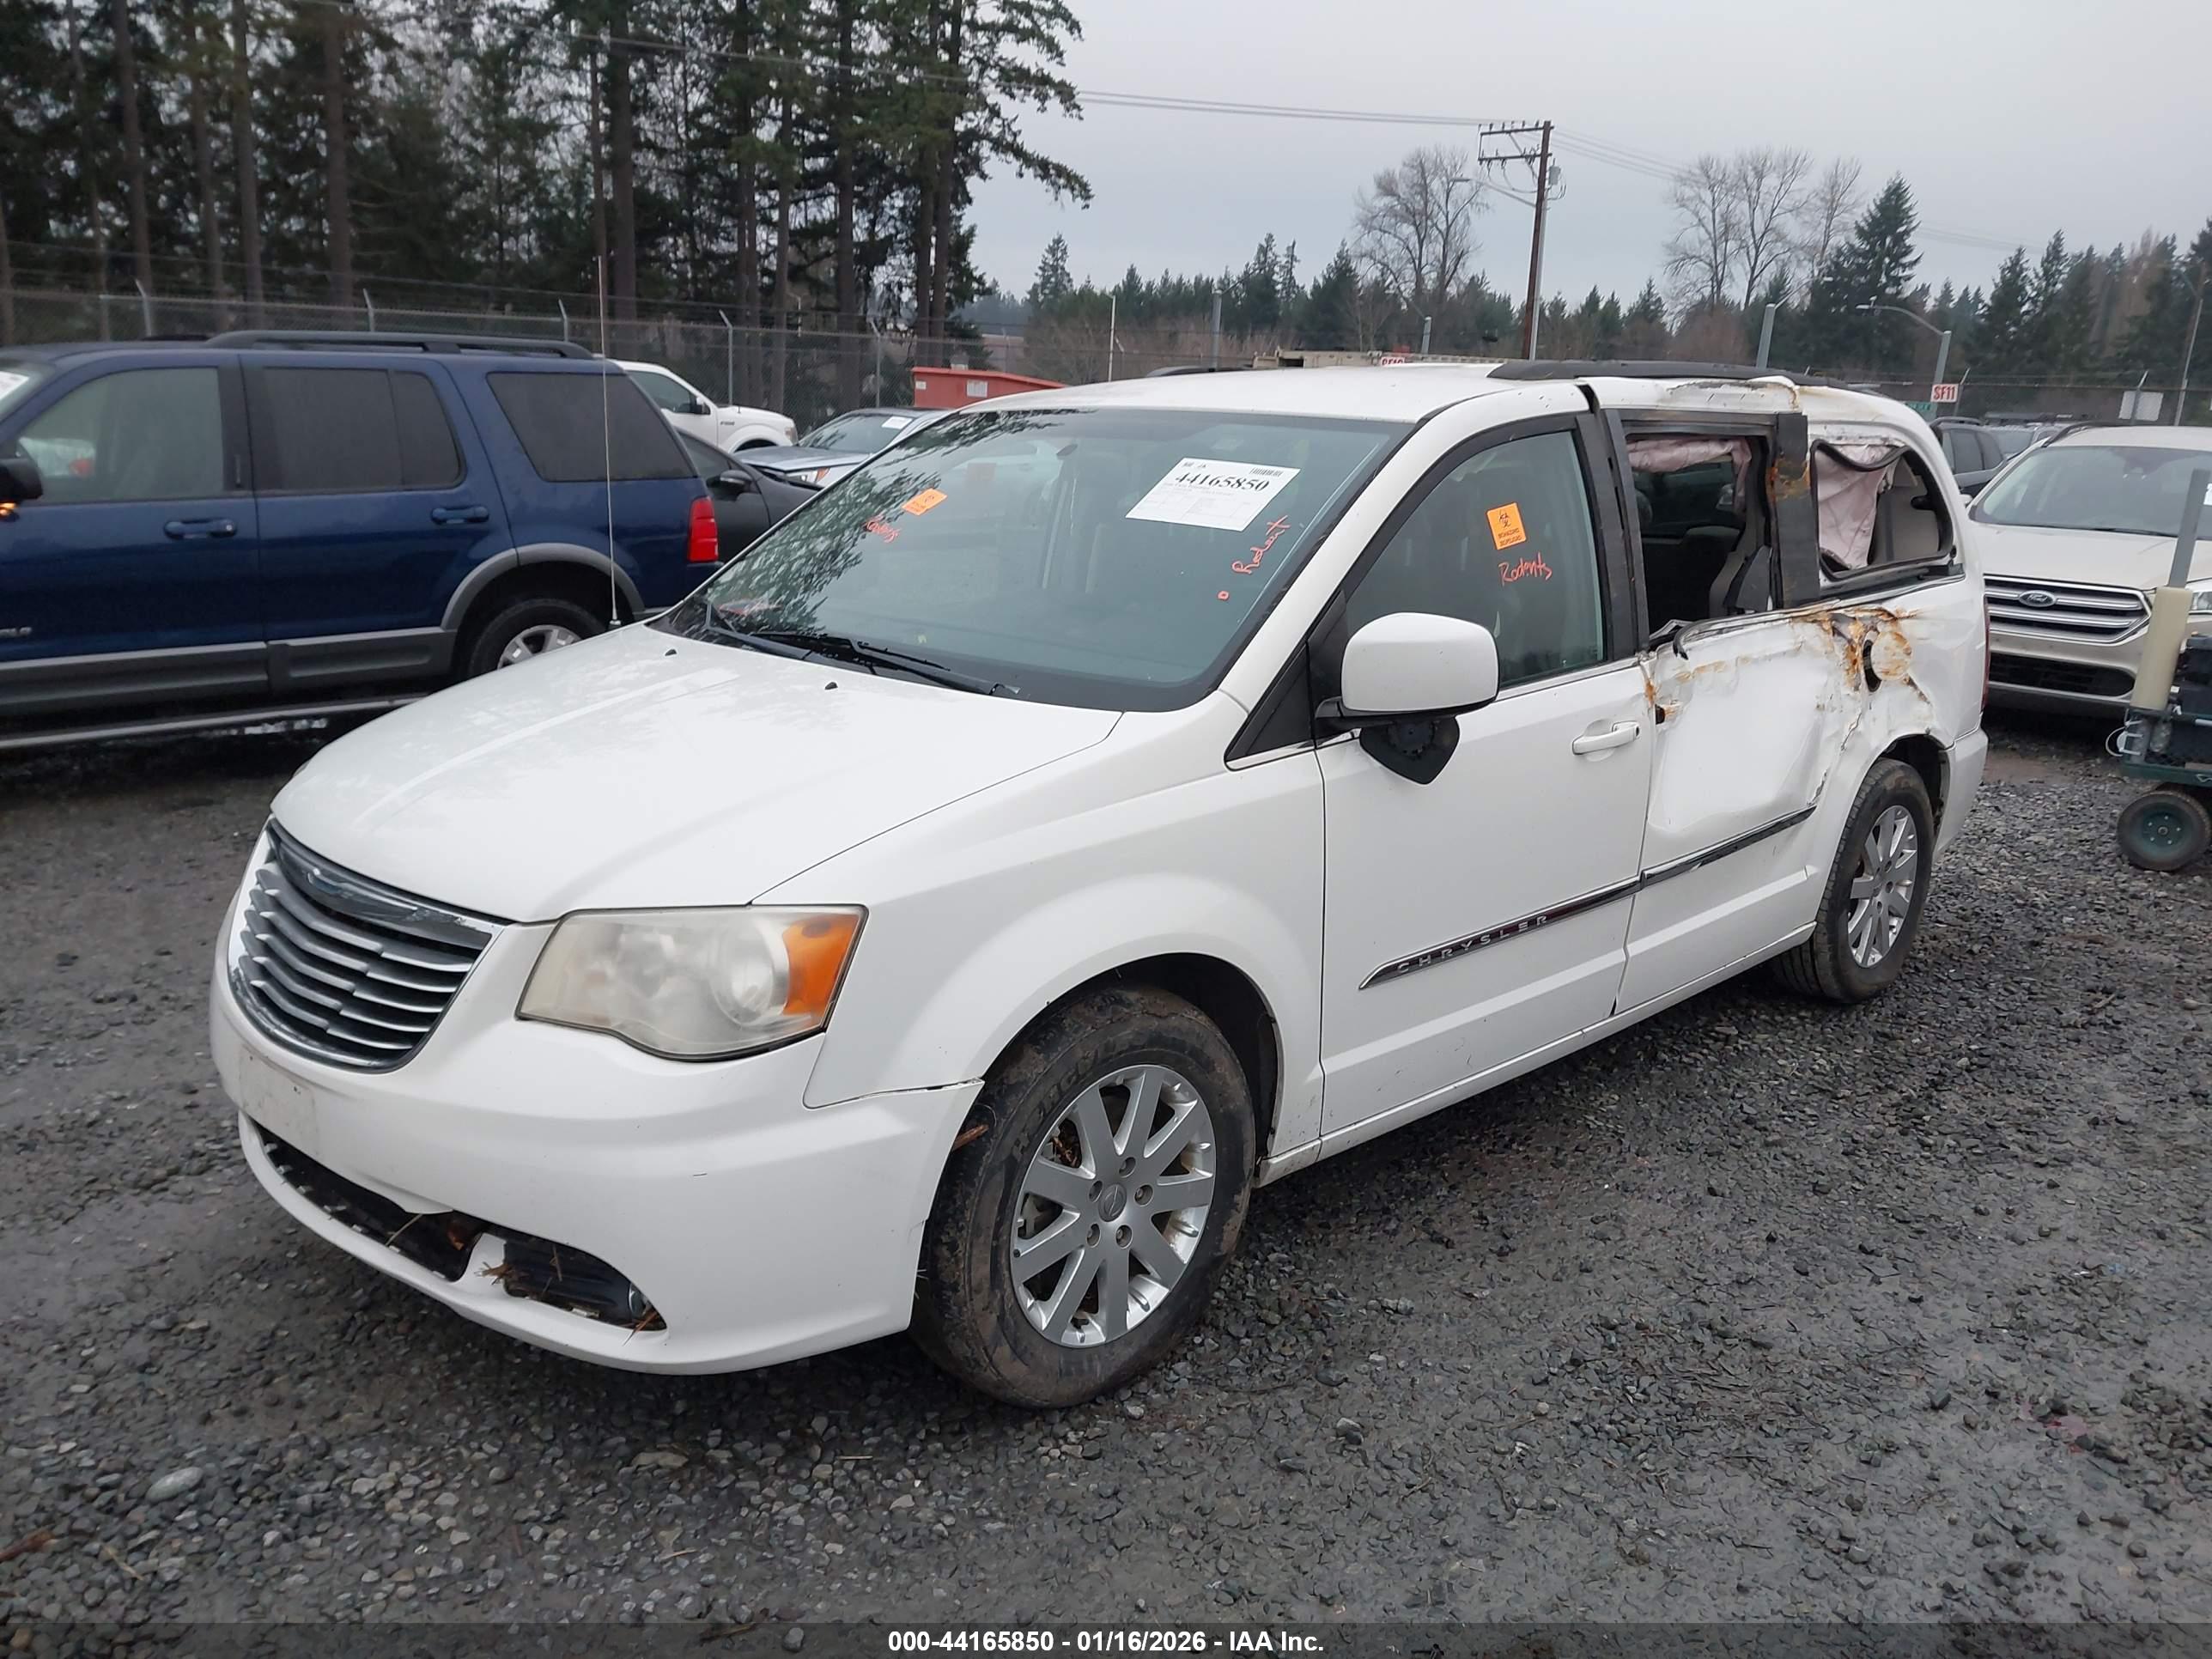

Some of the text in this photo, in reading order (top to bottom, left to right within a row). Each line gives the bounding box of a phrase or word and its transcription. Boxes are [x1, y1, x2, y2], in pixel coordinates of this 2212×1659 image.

[1933, 386, 1955, 400] SF11
[1175, 471, 1270, 492] 44165850
[1396, 915, 1547, 974] CHRYSLER
